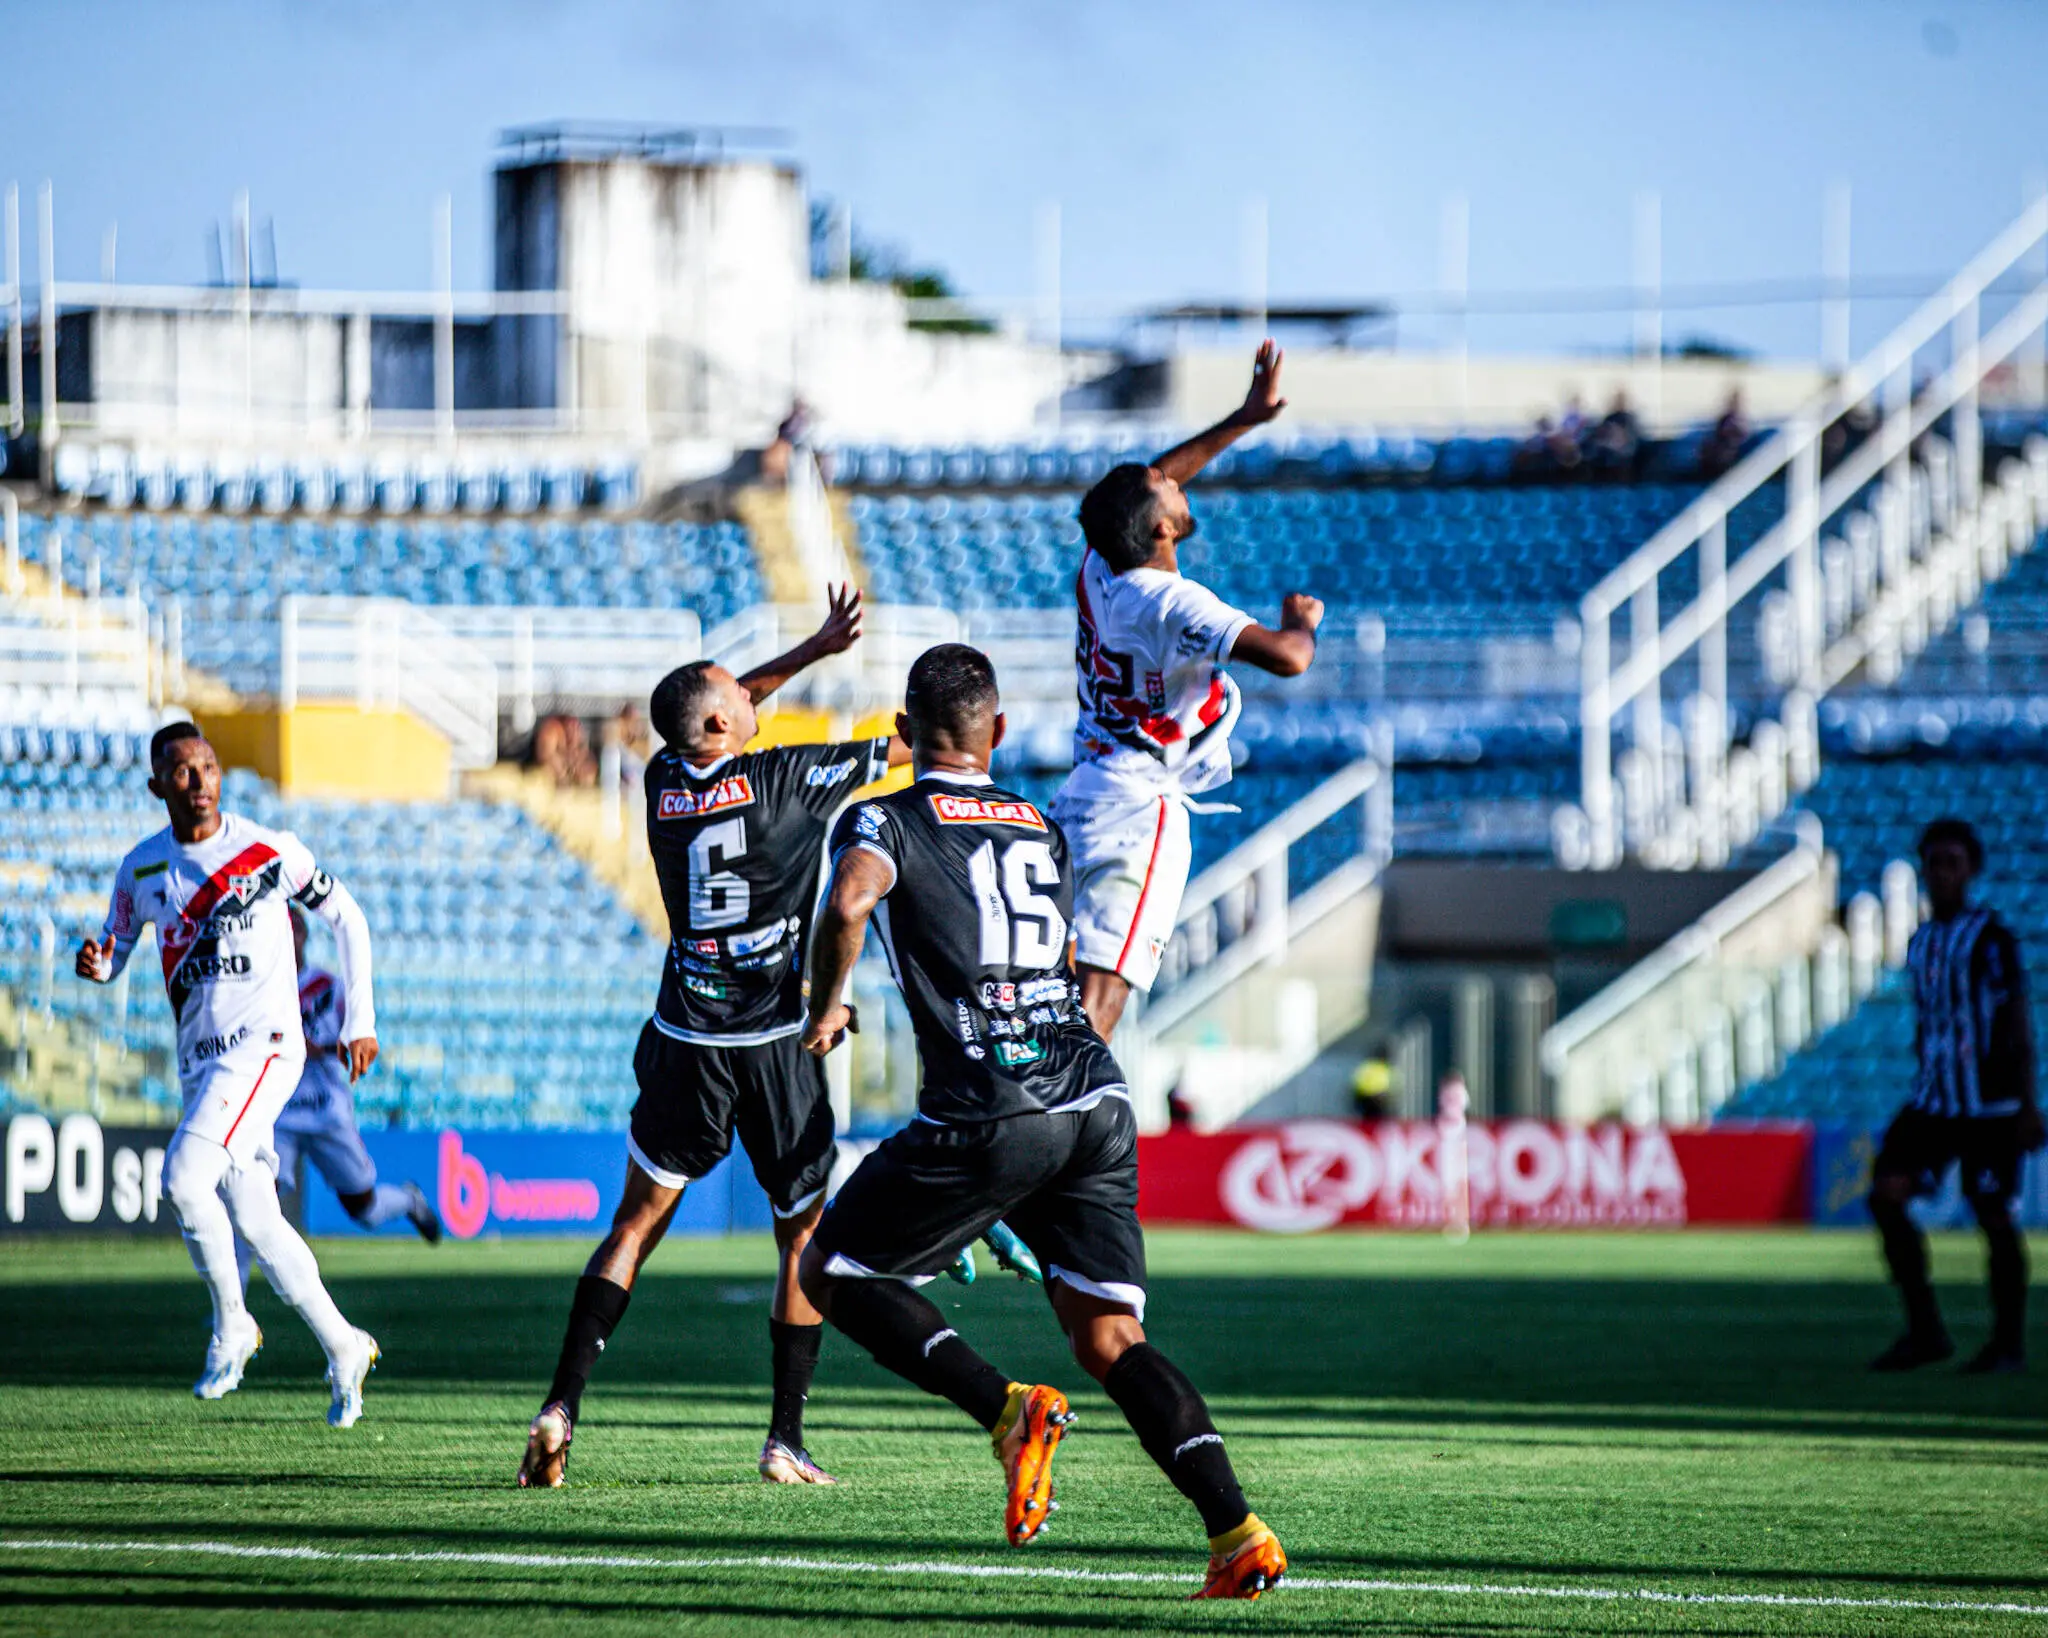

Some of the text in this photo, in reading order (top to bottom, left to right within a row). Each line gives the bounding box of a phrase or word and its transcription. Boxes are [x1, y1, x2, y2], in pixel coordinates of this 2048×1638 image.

[688, 816, 750, 930] 6
[968, 838, 1067, 970] 15
[5, 1113, 105, 1224] PO
[1374, 1119, 1688, 1204] KRONA
